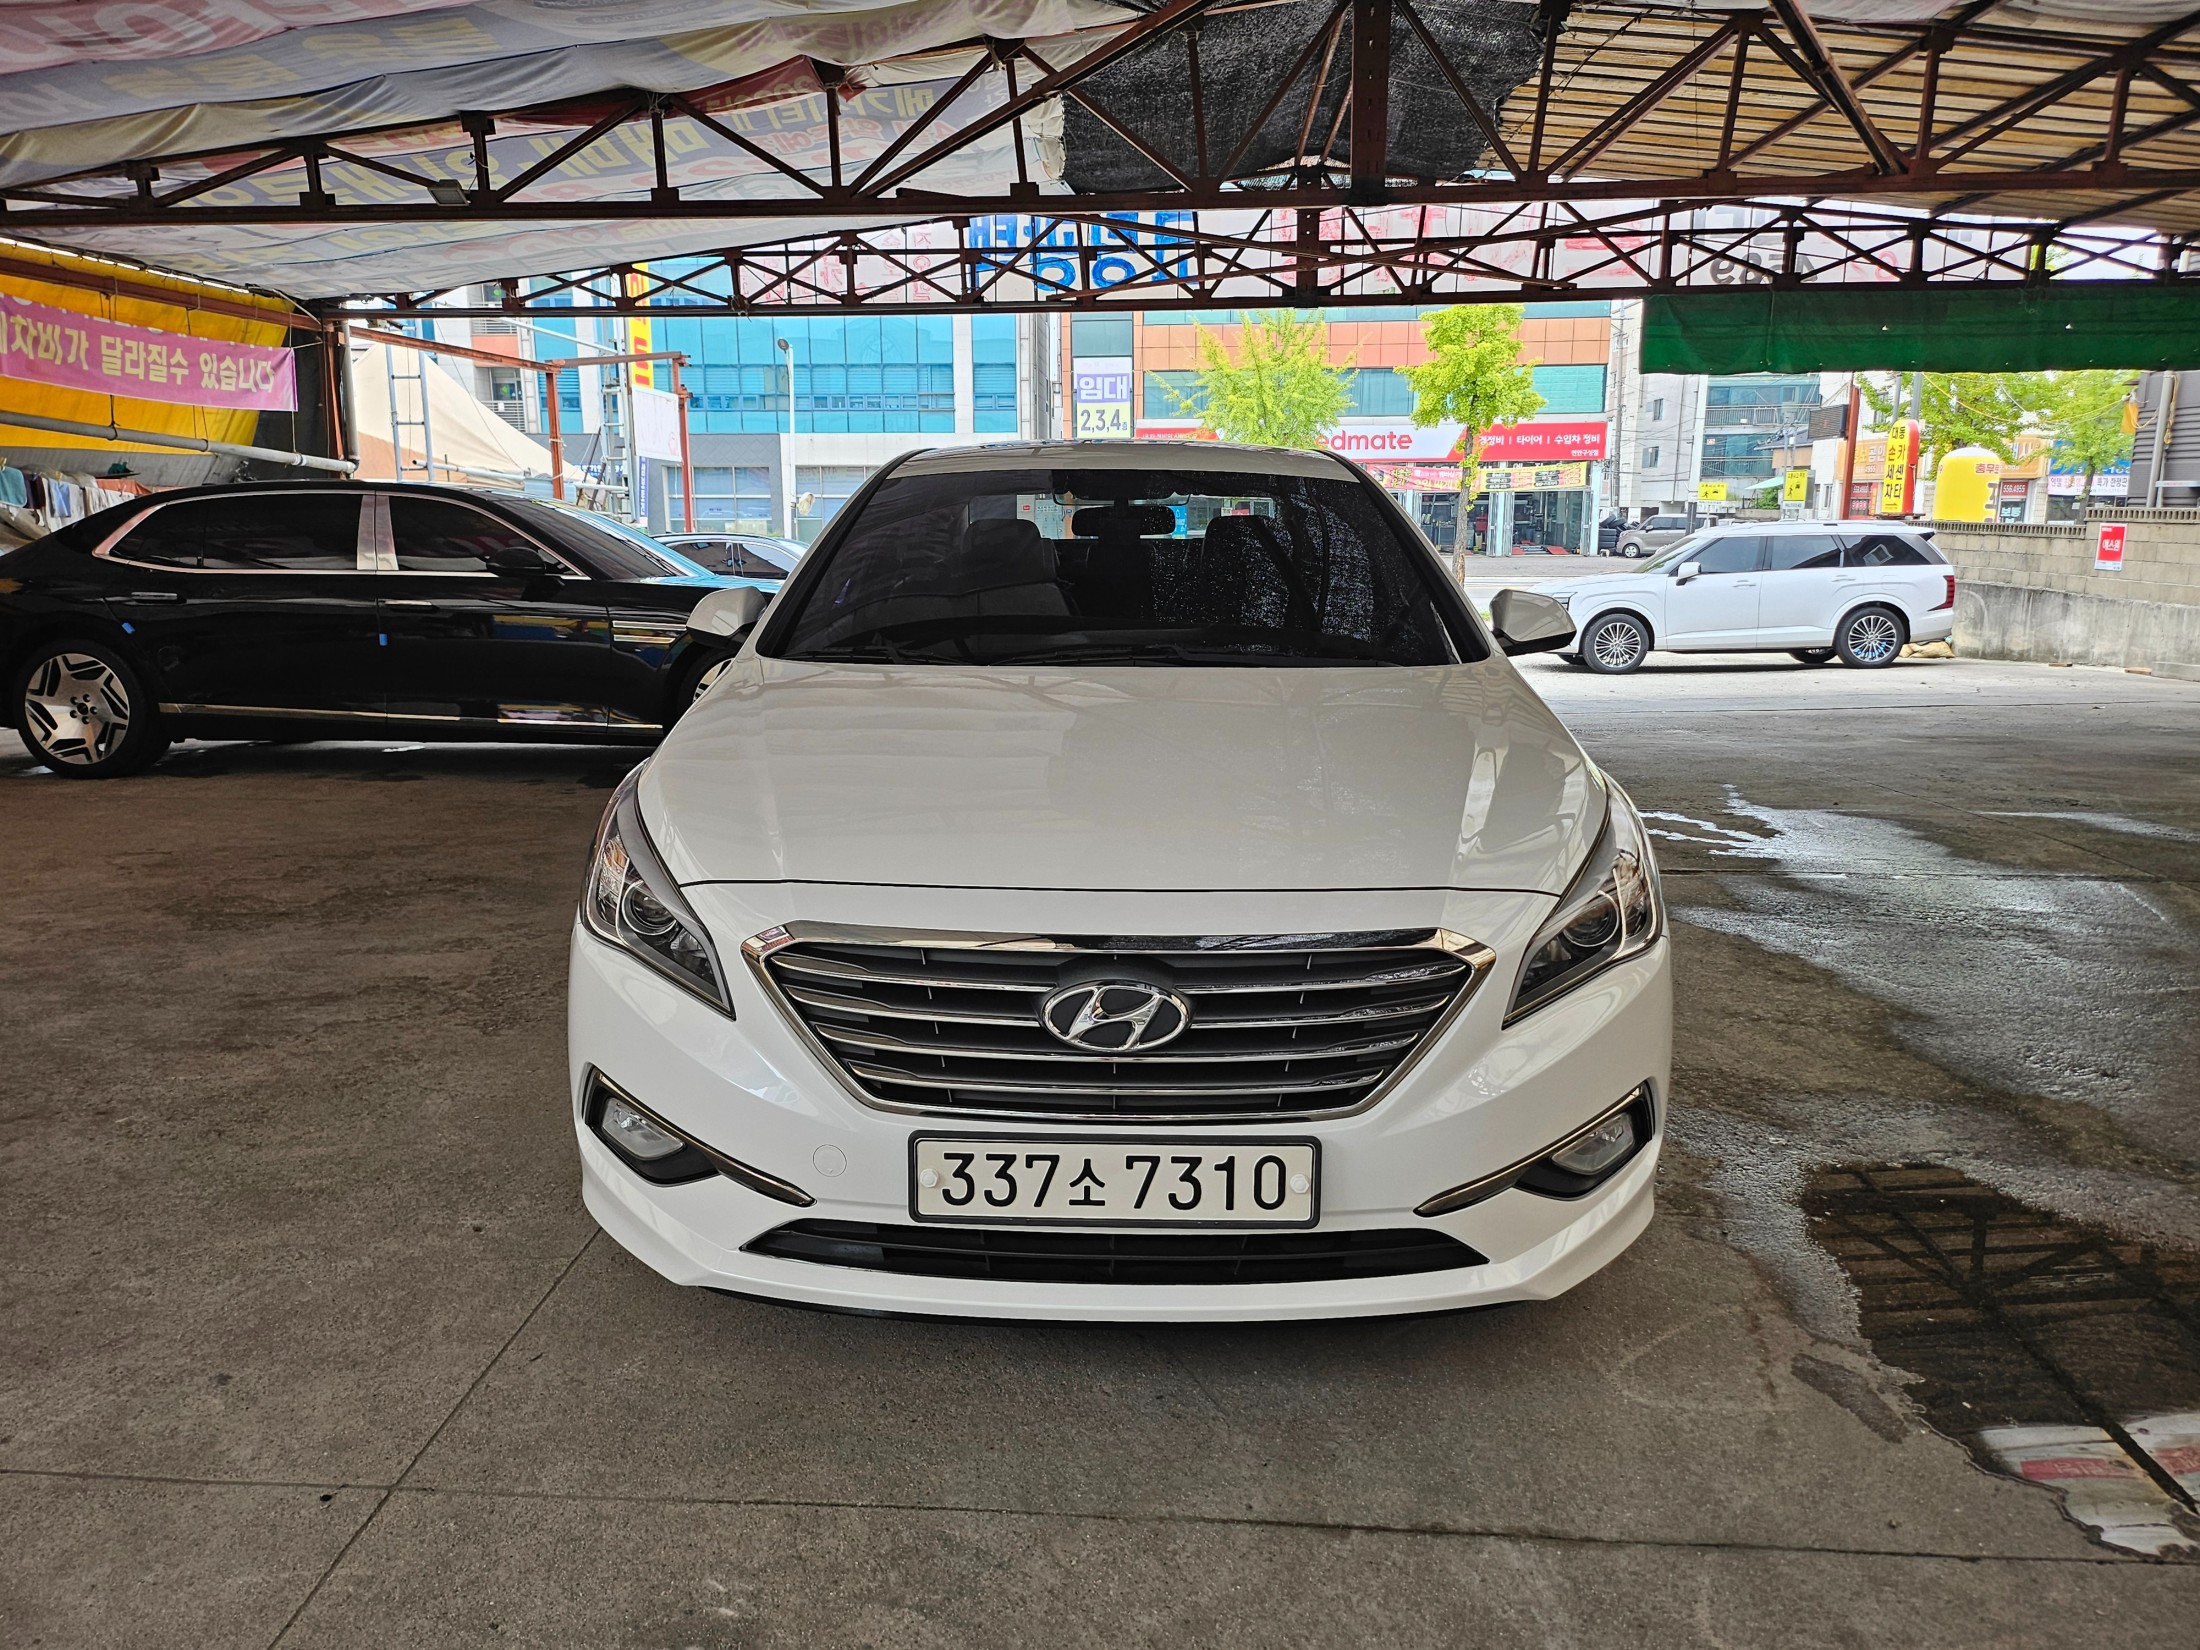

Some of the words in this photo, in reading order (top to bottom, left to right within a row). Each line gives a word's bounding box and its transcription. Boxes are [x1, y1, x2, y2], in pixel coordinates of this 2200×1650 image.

[101, 334, 190, 386] 달라질수
[200, 352, 275, 394] 있습니다
[1079, 375, 1128, 400] 임대
[1516, 434, 1542, 446] 타이어
[1554, 434, 1580, 446] 수입차
[1582, 434, 1600, 445] 정비
[1891, 426, 1906, 441] 대동
[942, 1152, 1105, 1208] 337소
[1125, 1154, 1287, 1211] 7310
